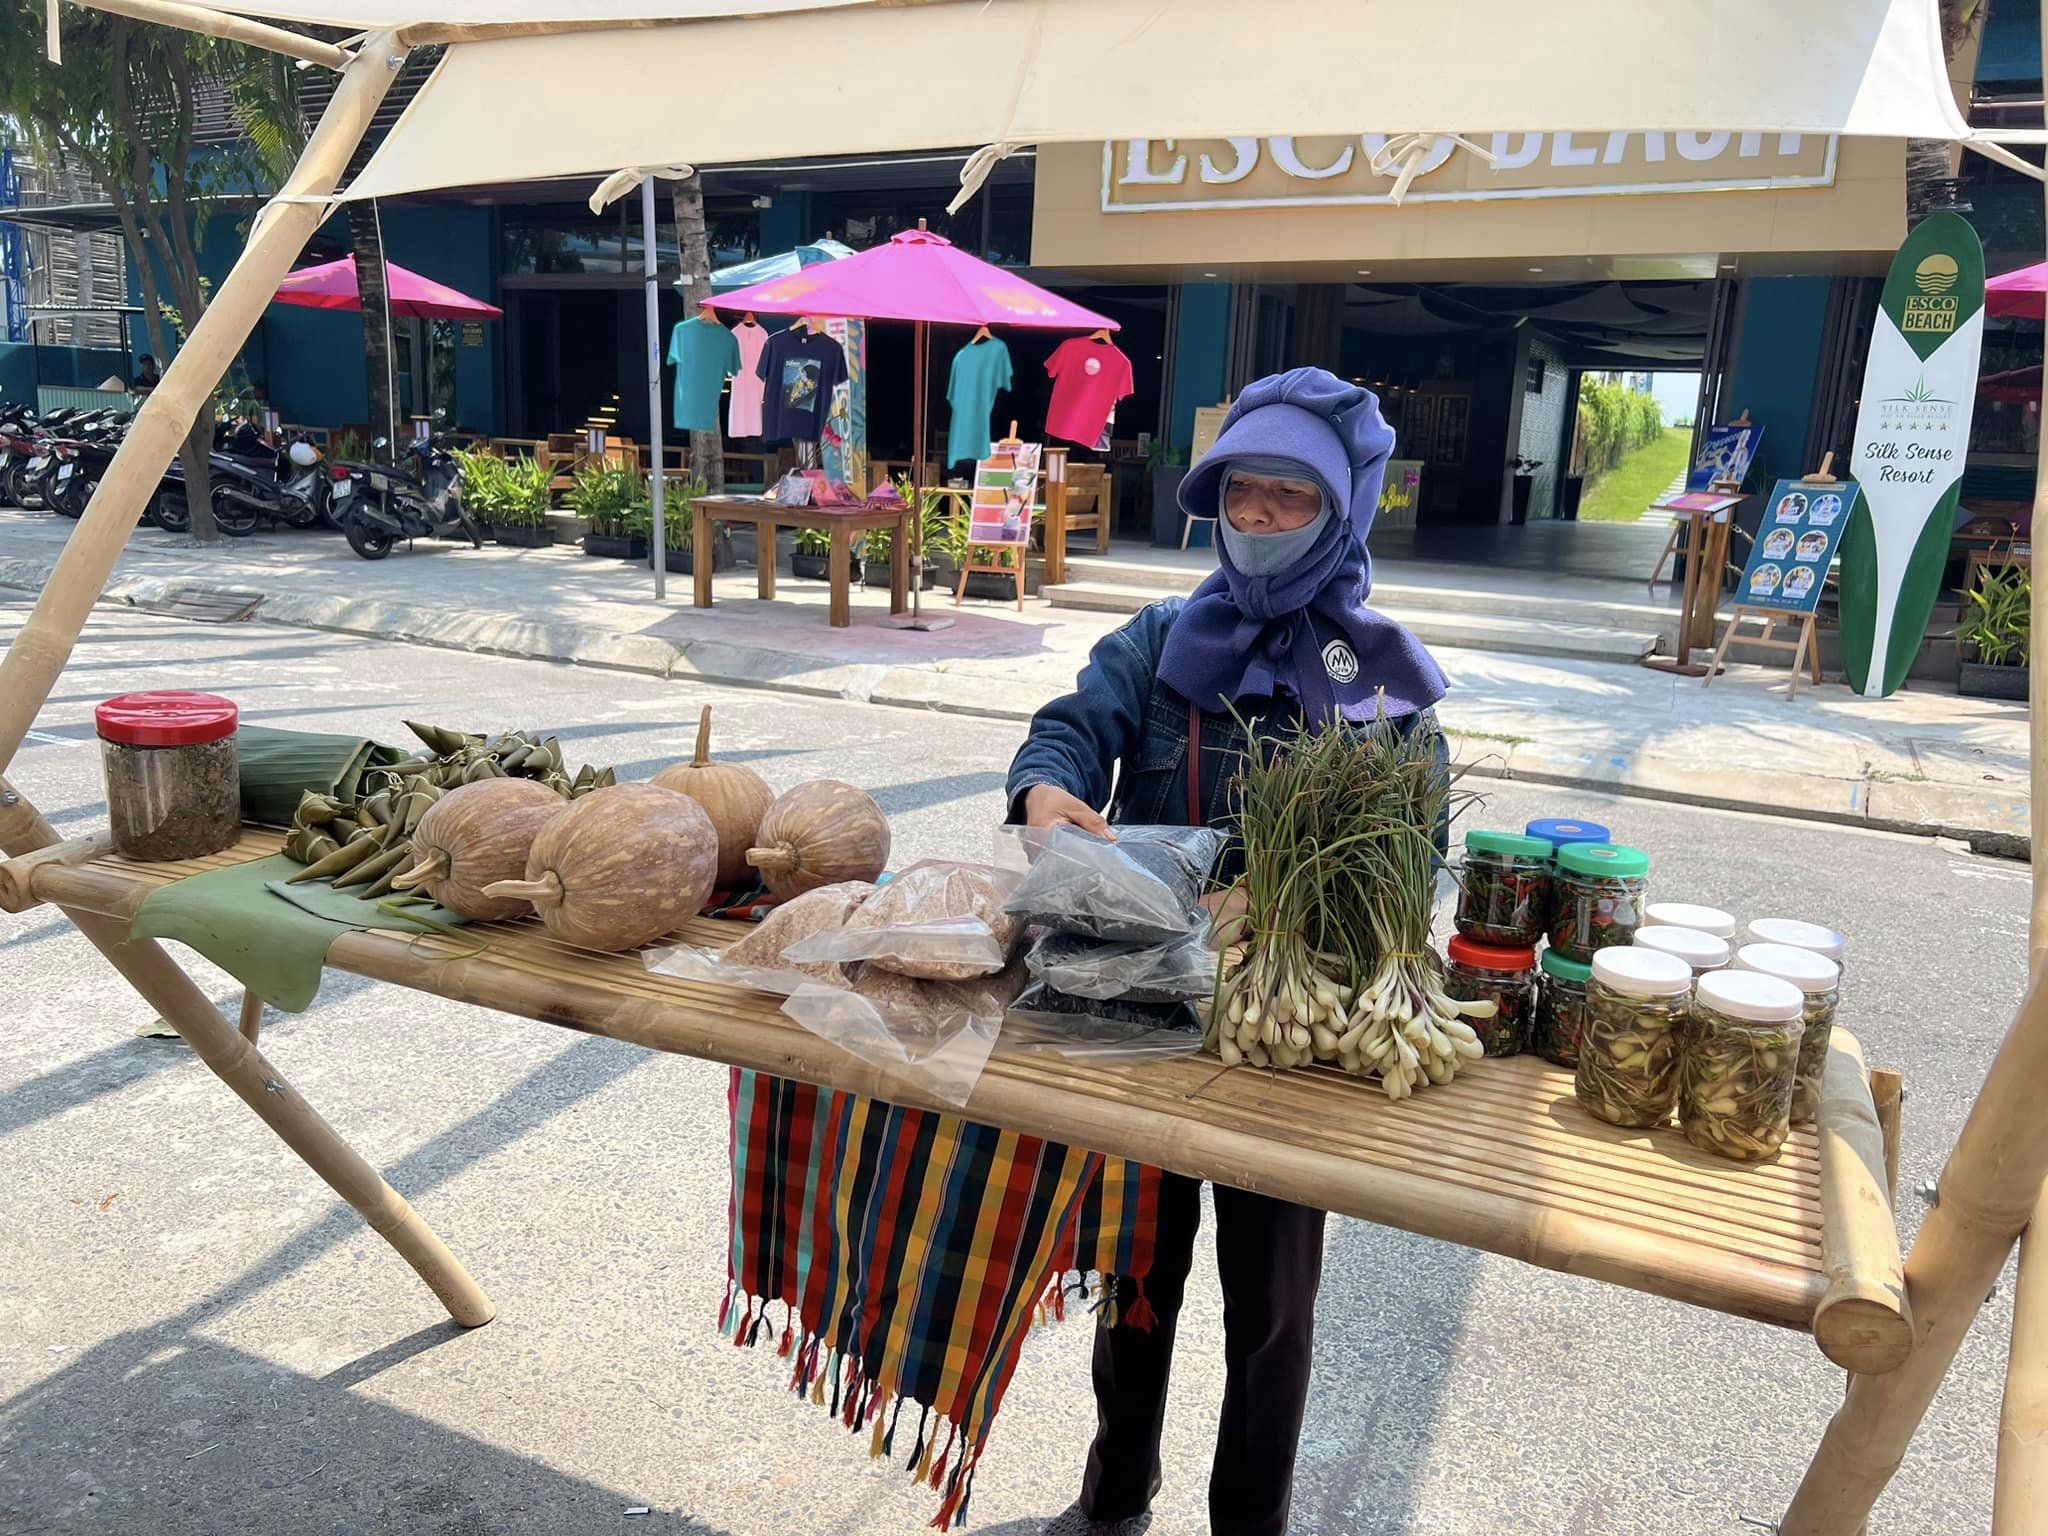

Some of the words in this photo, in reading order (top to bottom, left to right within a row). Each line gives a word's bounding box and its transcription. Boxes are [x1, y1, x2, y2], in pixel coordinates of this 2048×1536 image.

[1908, 297, 1956, 310] ESCO
[1905, 312, 1953, 329] BEACH
[1864, 441, 1899, 460] Silk
[1905, 442, 1953, 461] Sense
[1879, 464, 1936, 484] Resort
